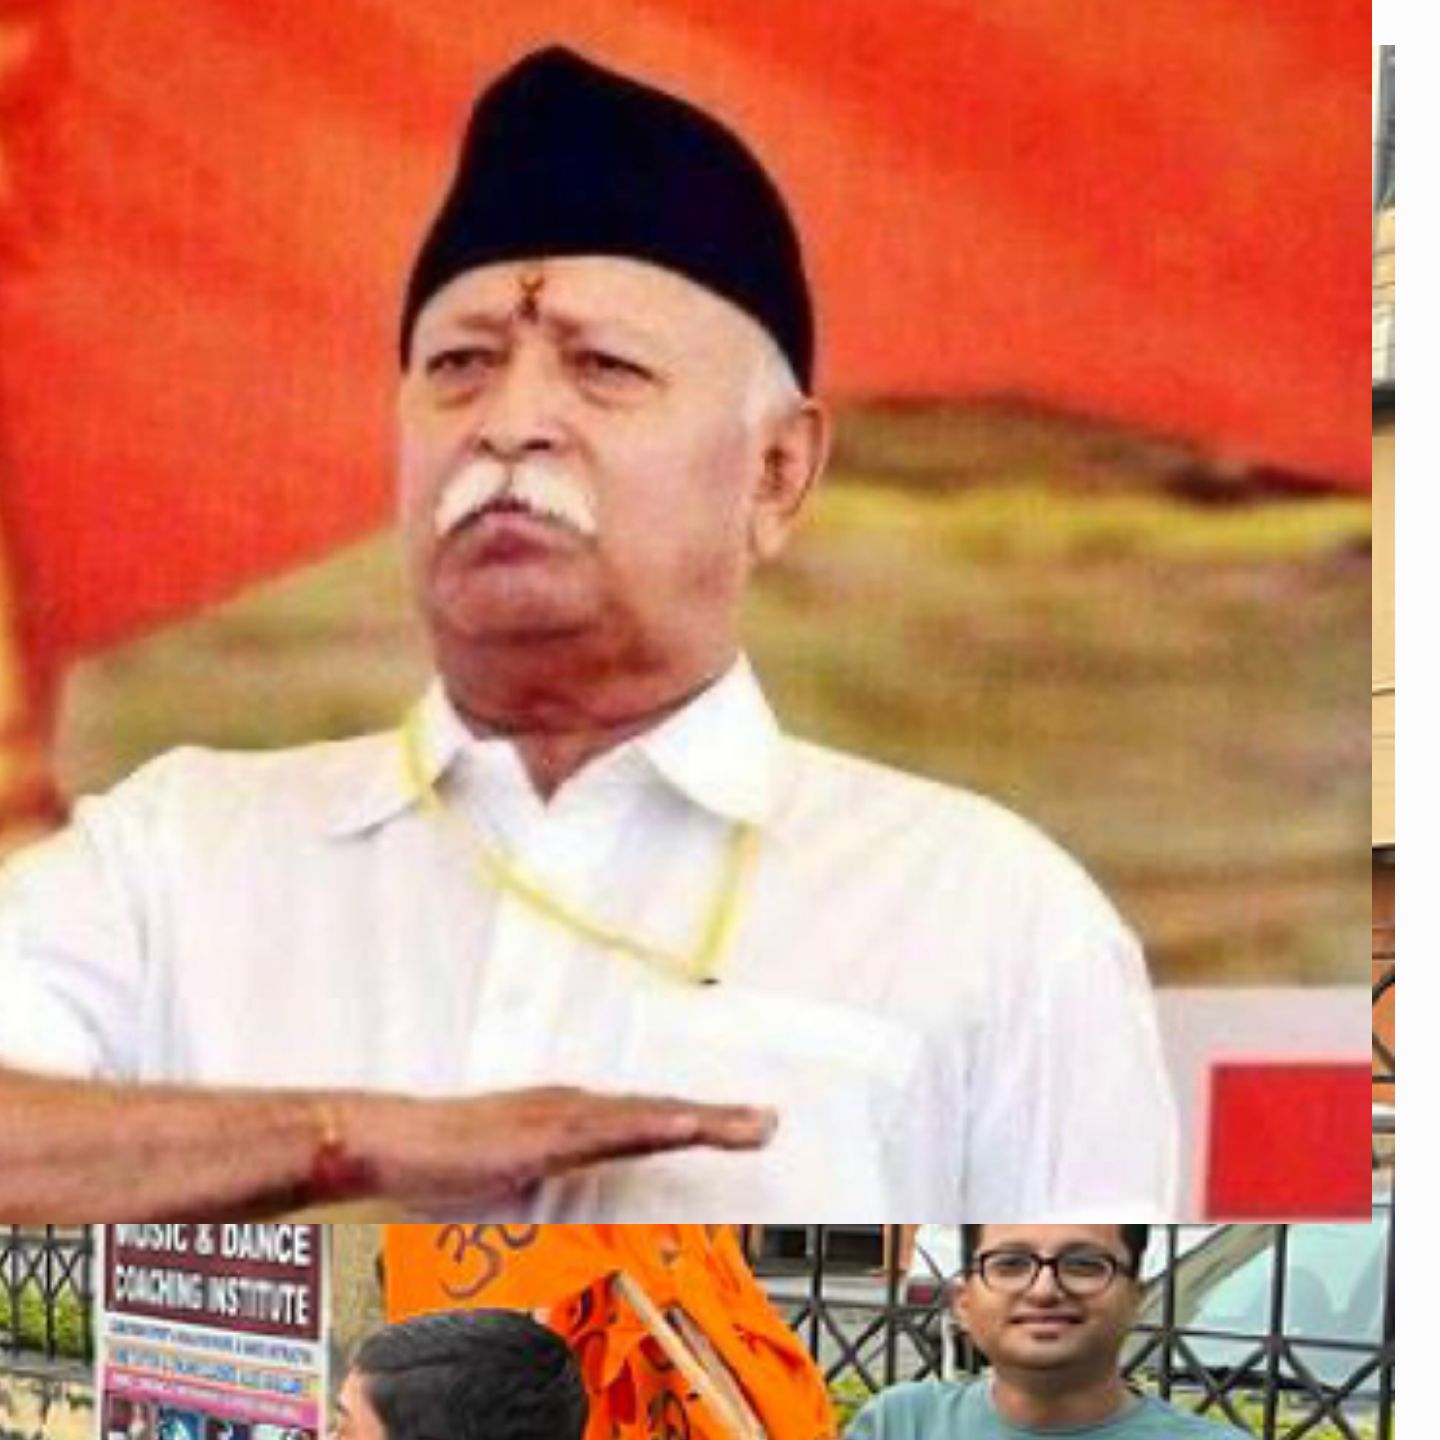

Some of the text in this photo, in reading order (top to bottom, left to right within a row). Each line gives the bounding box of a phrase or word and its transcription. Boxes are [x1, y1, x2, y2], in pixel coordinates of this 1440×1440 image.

[116, 1224, 311, 1267] MUSIC & DANCE
[116, 1264, 310, 1325] COACHING INSTITUTE
